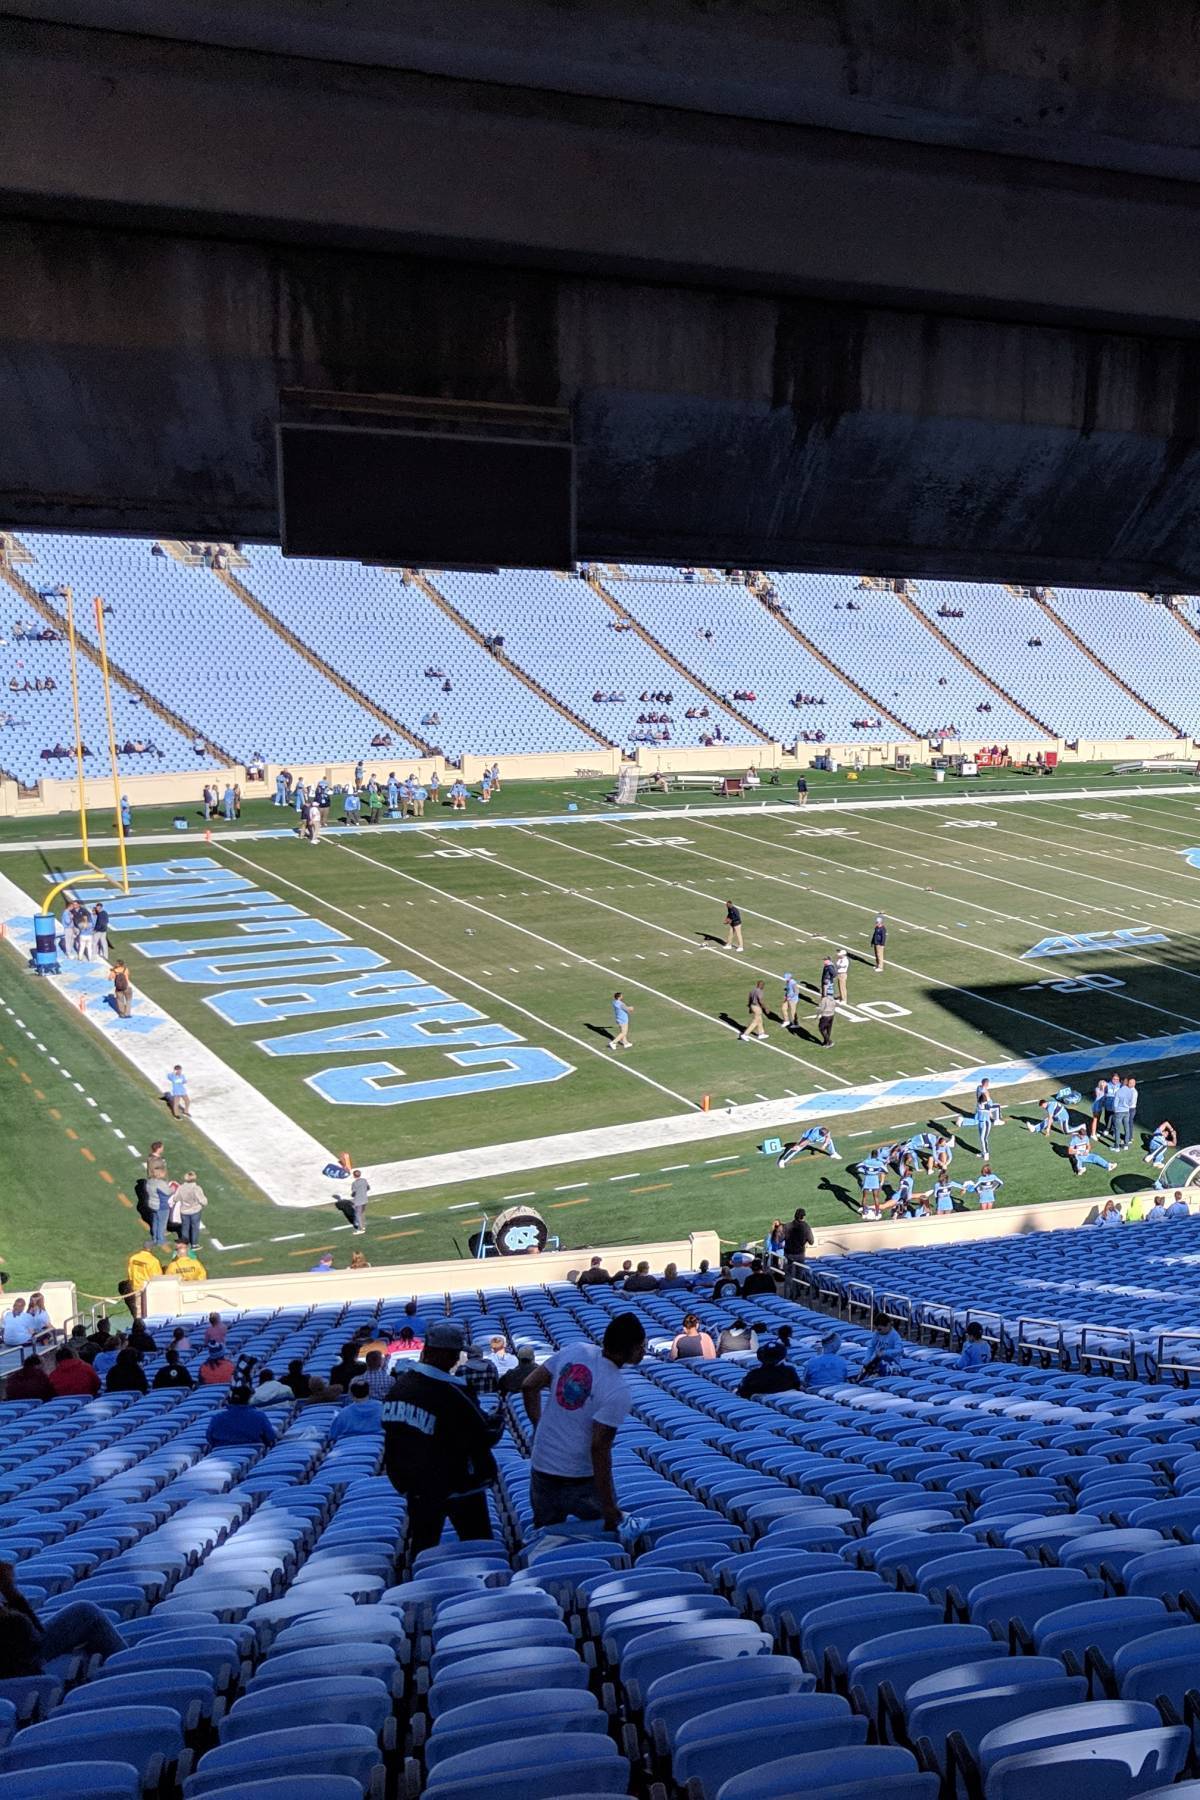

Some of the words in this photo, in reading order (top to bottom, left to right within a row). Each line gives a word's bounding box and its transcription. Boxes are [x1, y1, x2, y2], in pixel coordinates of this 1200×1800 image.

[1019, 926, 1171, 959] ACC
[43, 857, 577, 1105] CAROLINA
[1038, 973, 1126, 993] 20
[834, 1000, 912, 1022] 10
